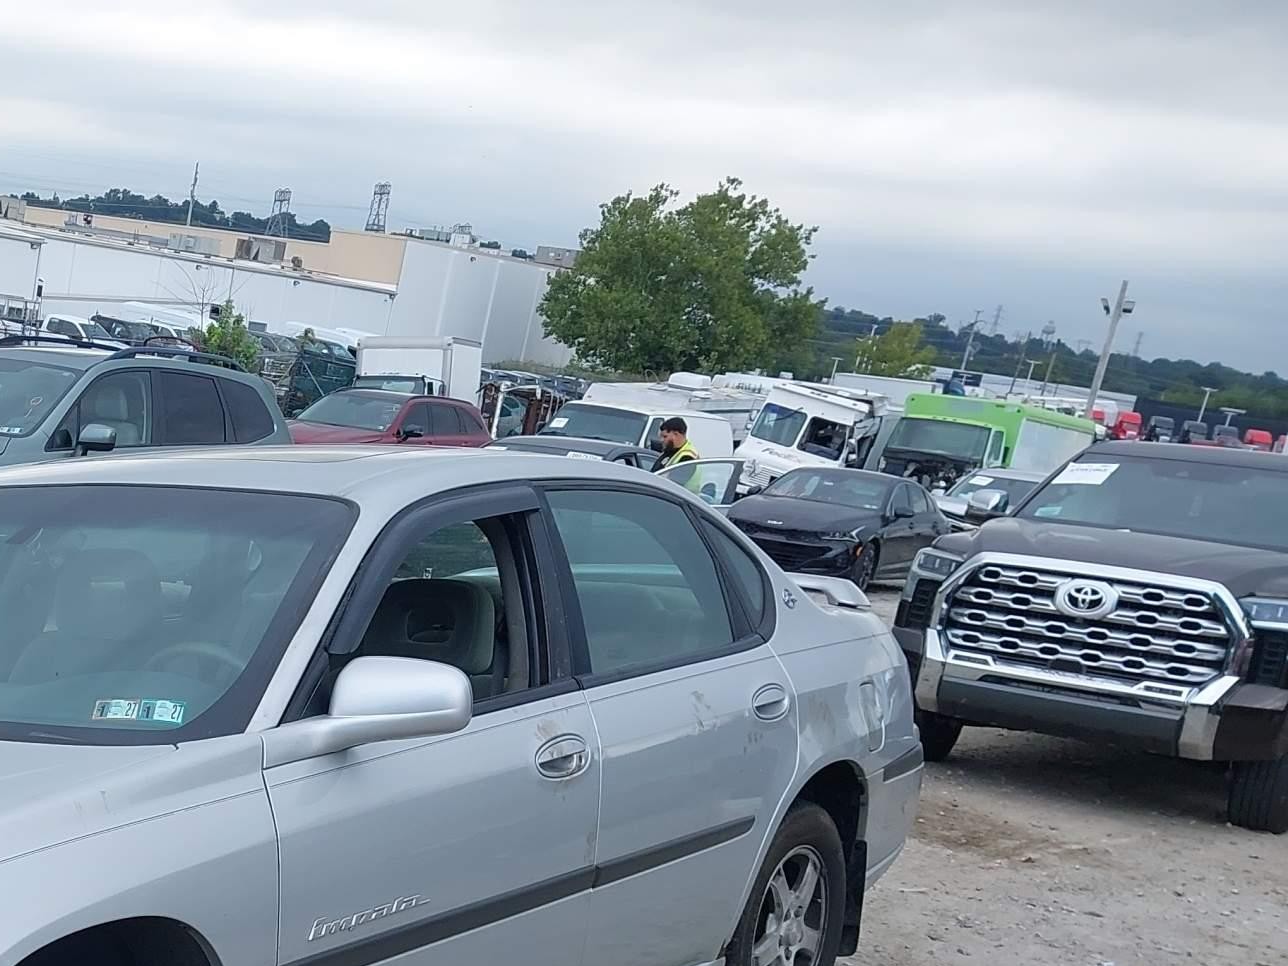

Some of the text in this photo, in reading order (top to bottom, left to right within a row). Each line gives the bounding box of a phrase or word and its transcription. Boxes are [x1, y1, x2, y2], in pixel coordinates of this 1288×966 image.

[125, 702, 137, 717] 27
[171, 704, 183, 720] 27
[308, 894, 431, 941] Impala
